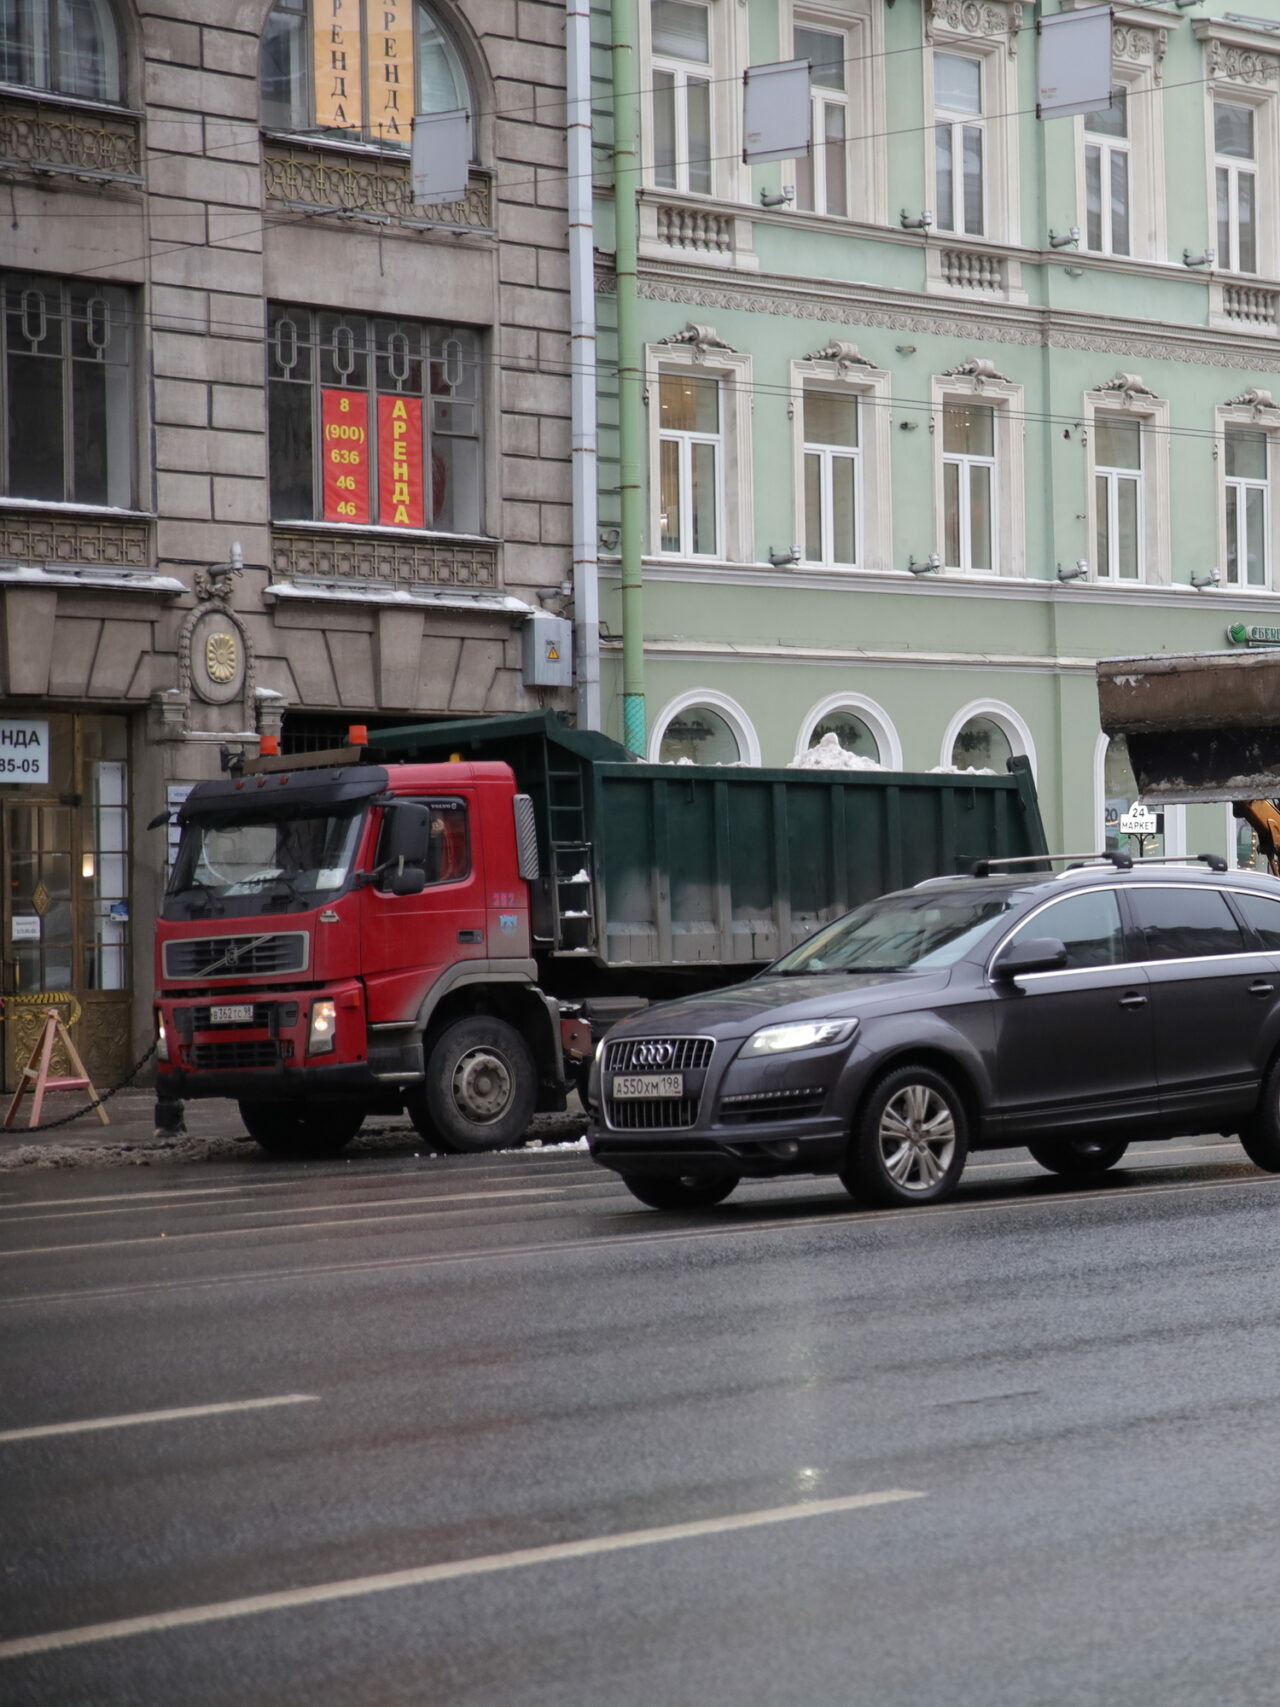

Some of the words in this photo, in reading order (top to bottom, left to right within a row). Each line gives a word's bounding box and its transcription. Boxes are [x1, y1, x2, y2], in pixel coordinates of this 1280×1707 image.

[339, 398, 350, 413] 8
[325, 423, 365, 444] (900)
[330, 449, 360, 465] 636
[391, 399, 410, 525] АРЕНДА
[336, 475, 356, 490] 46
[336, 501, 356, 516] 46
[1132, 807, 1145, 818] 24
[1121, 821, 1155, 831] МАРКЕТ
[616, 1078, 659, 1096] А550ХМ
[661, 1076, 680, 1090] 198
